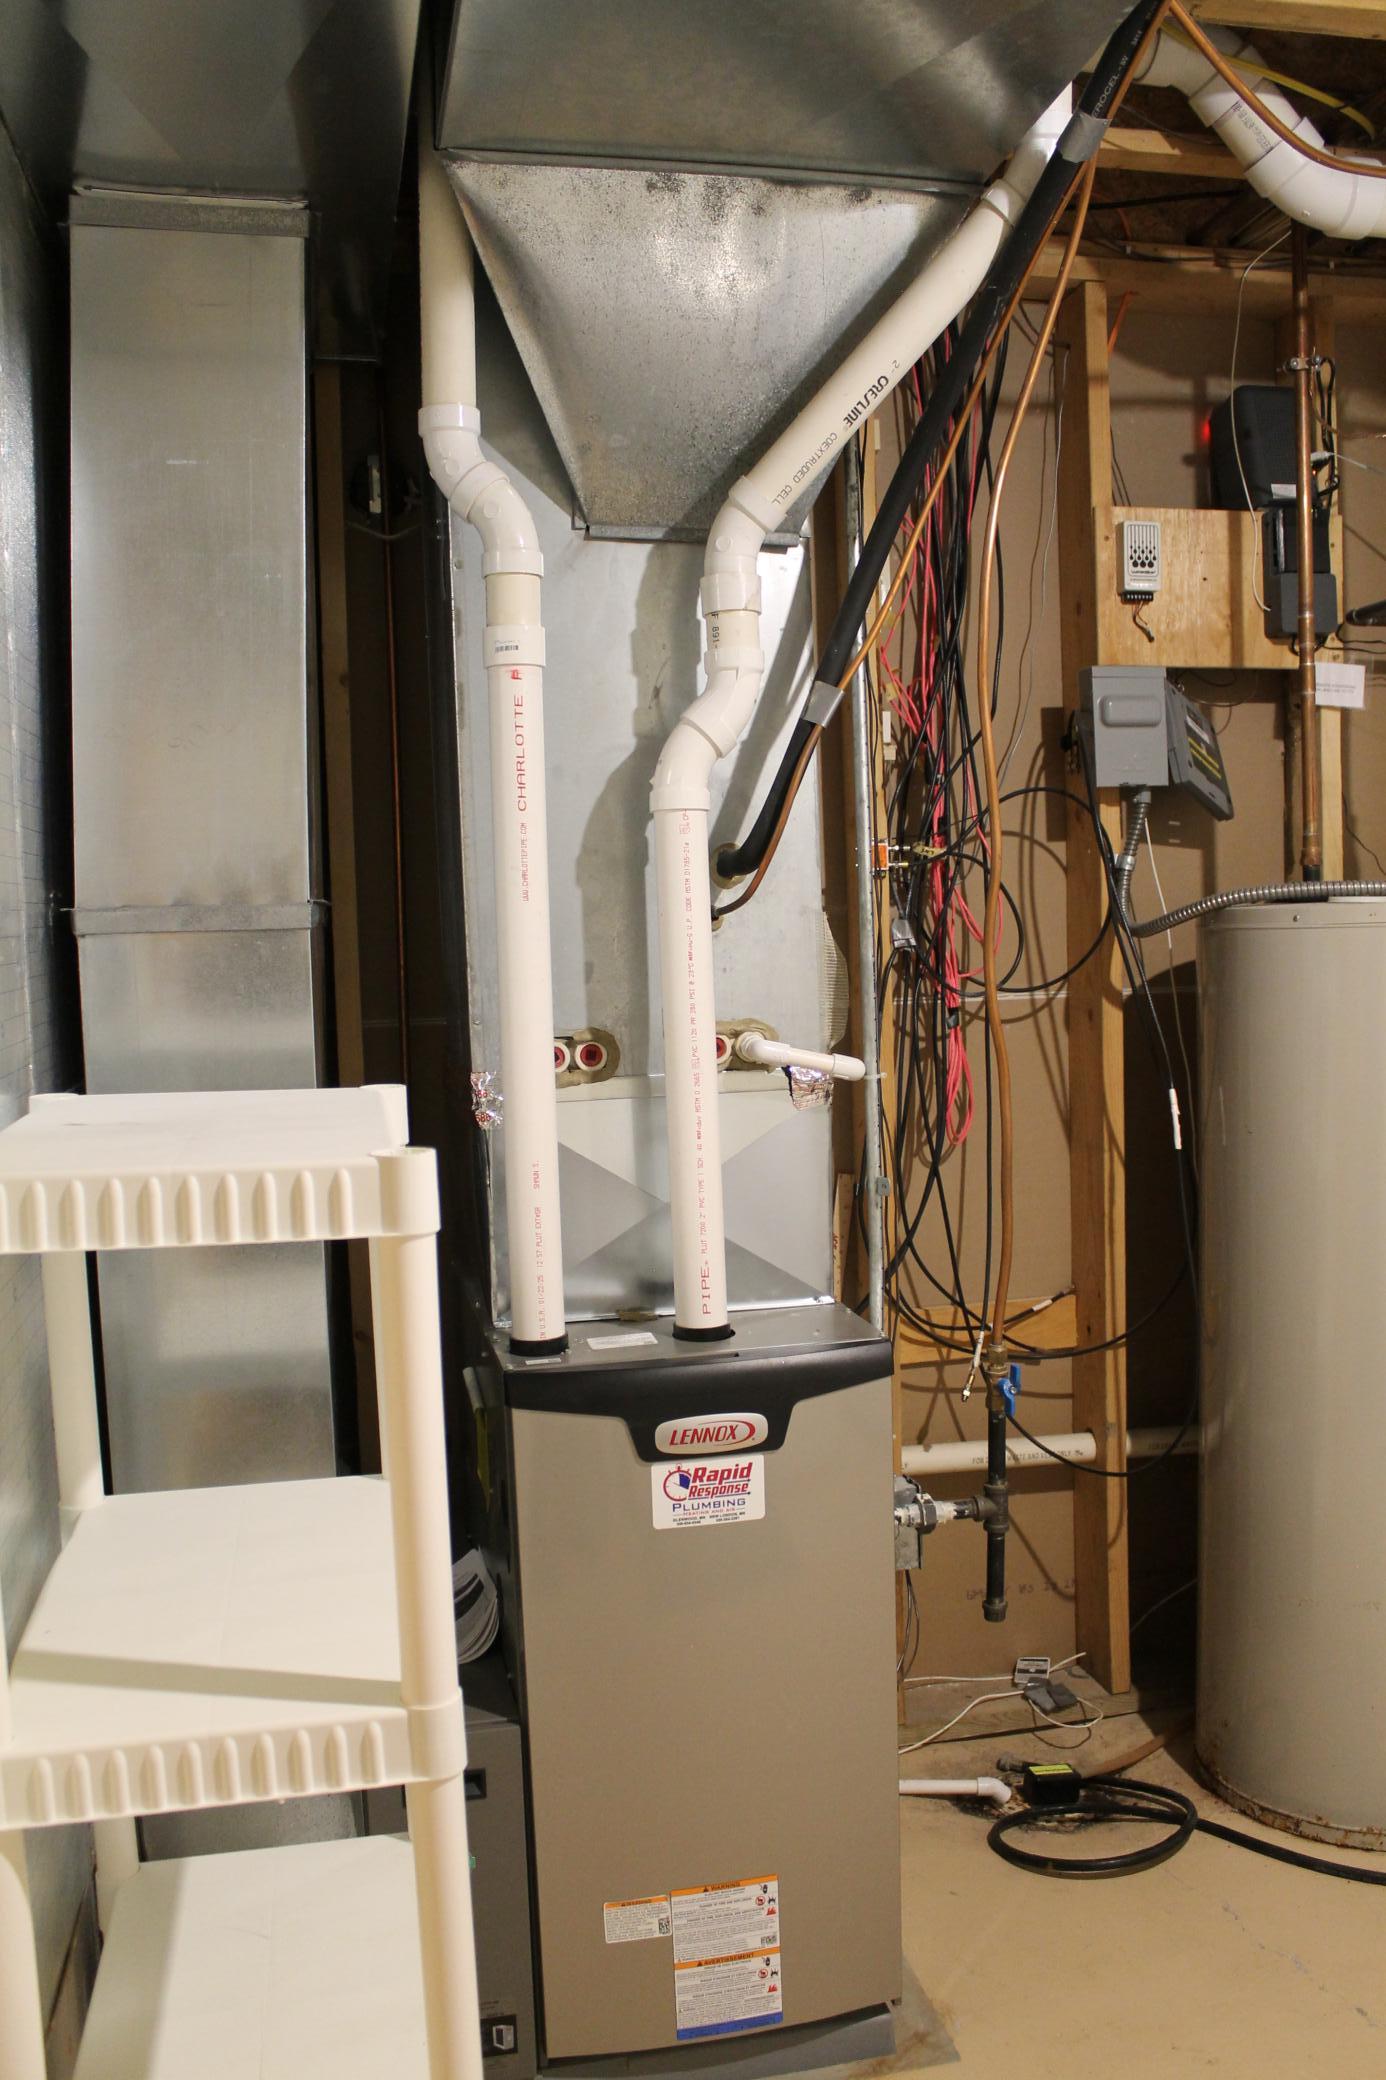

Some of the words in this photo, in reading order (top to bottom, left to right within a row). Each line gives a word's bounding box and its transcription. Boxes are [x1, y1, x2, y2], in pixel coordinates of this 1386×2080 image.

[843, 375, 889, 428] CRESLINE
[793, 432, 838, 484] COEXTRUDED
[772, 484, 793, 505] CELL
[513, 694, 527, 812] CHARLOTTE
[669, 1424, 739, 1446] LENNOX
[692, 1462, 753, 1485] Rapid
[688, 1482, 749, 1499] Response
[672, 1498, 746, 1512] PLUMBING
